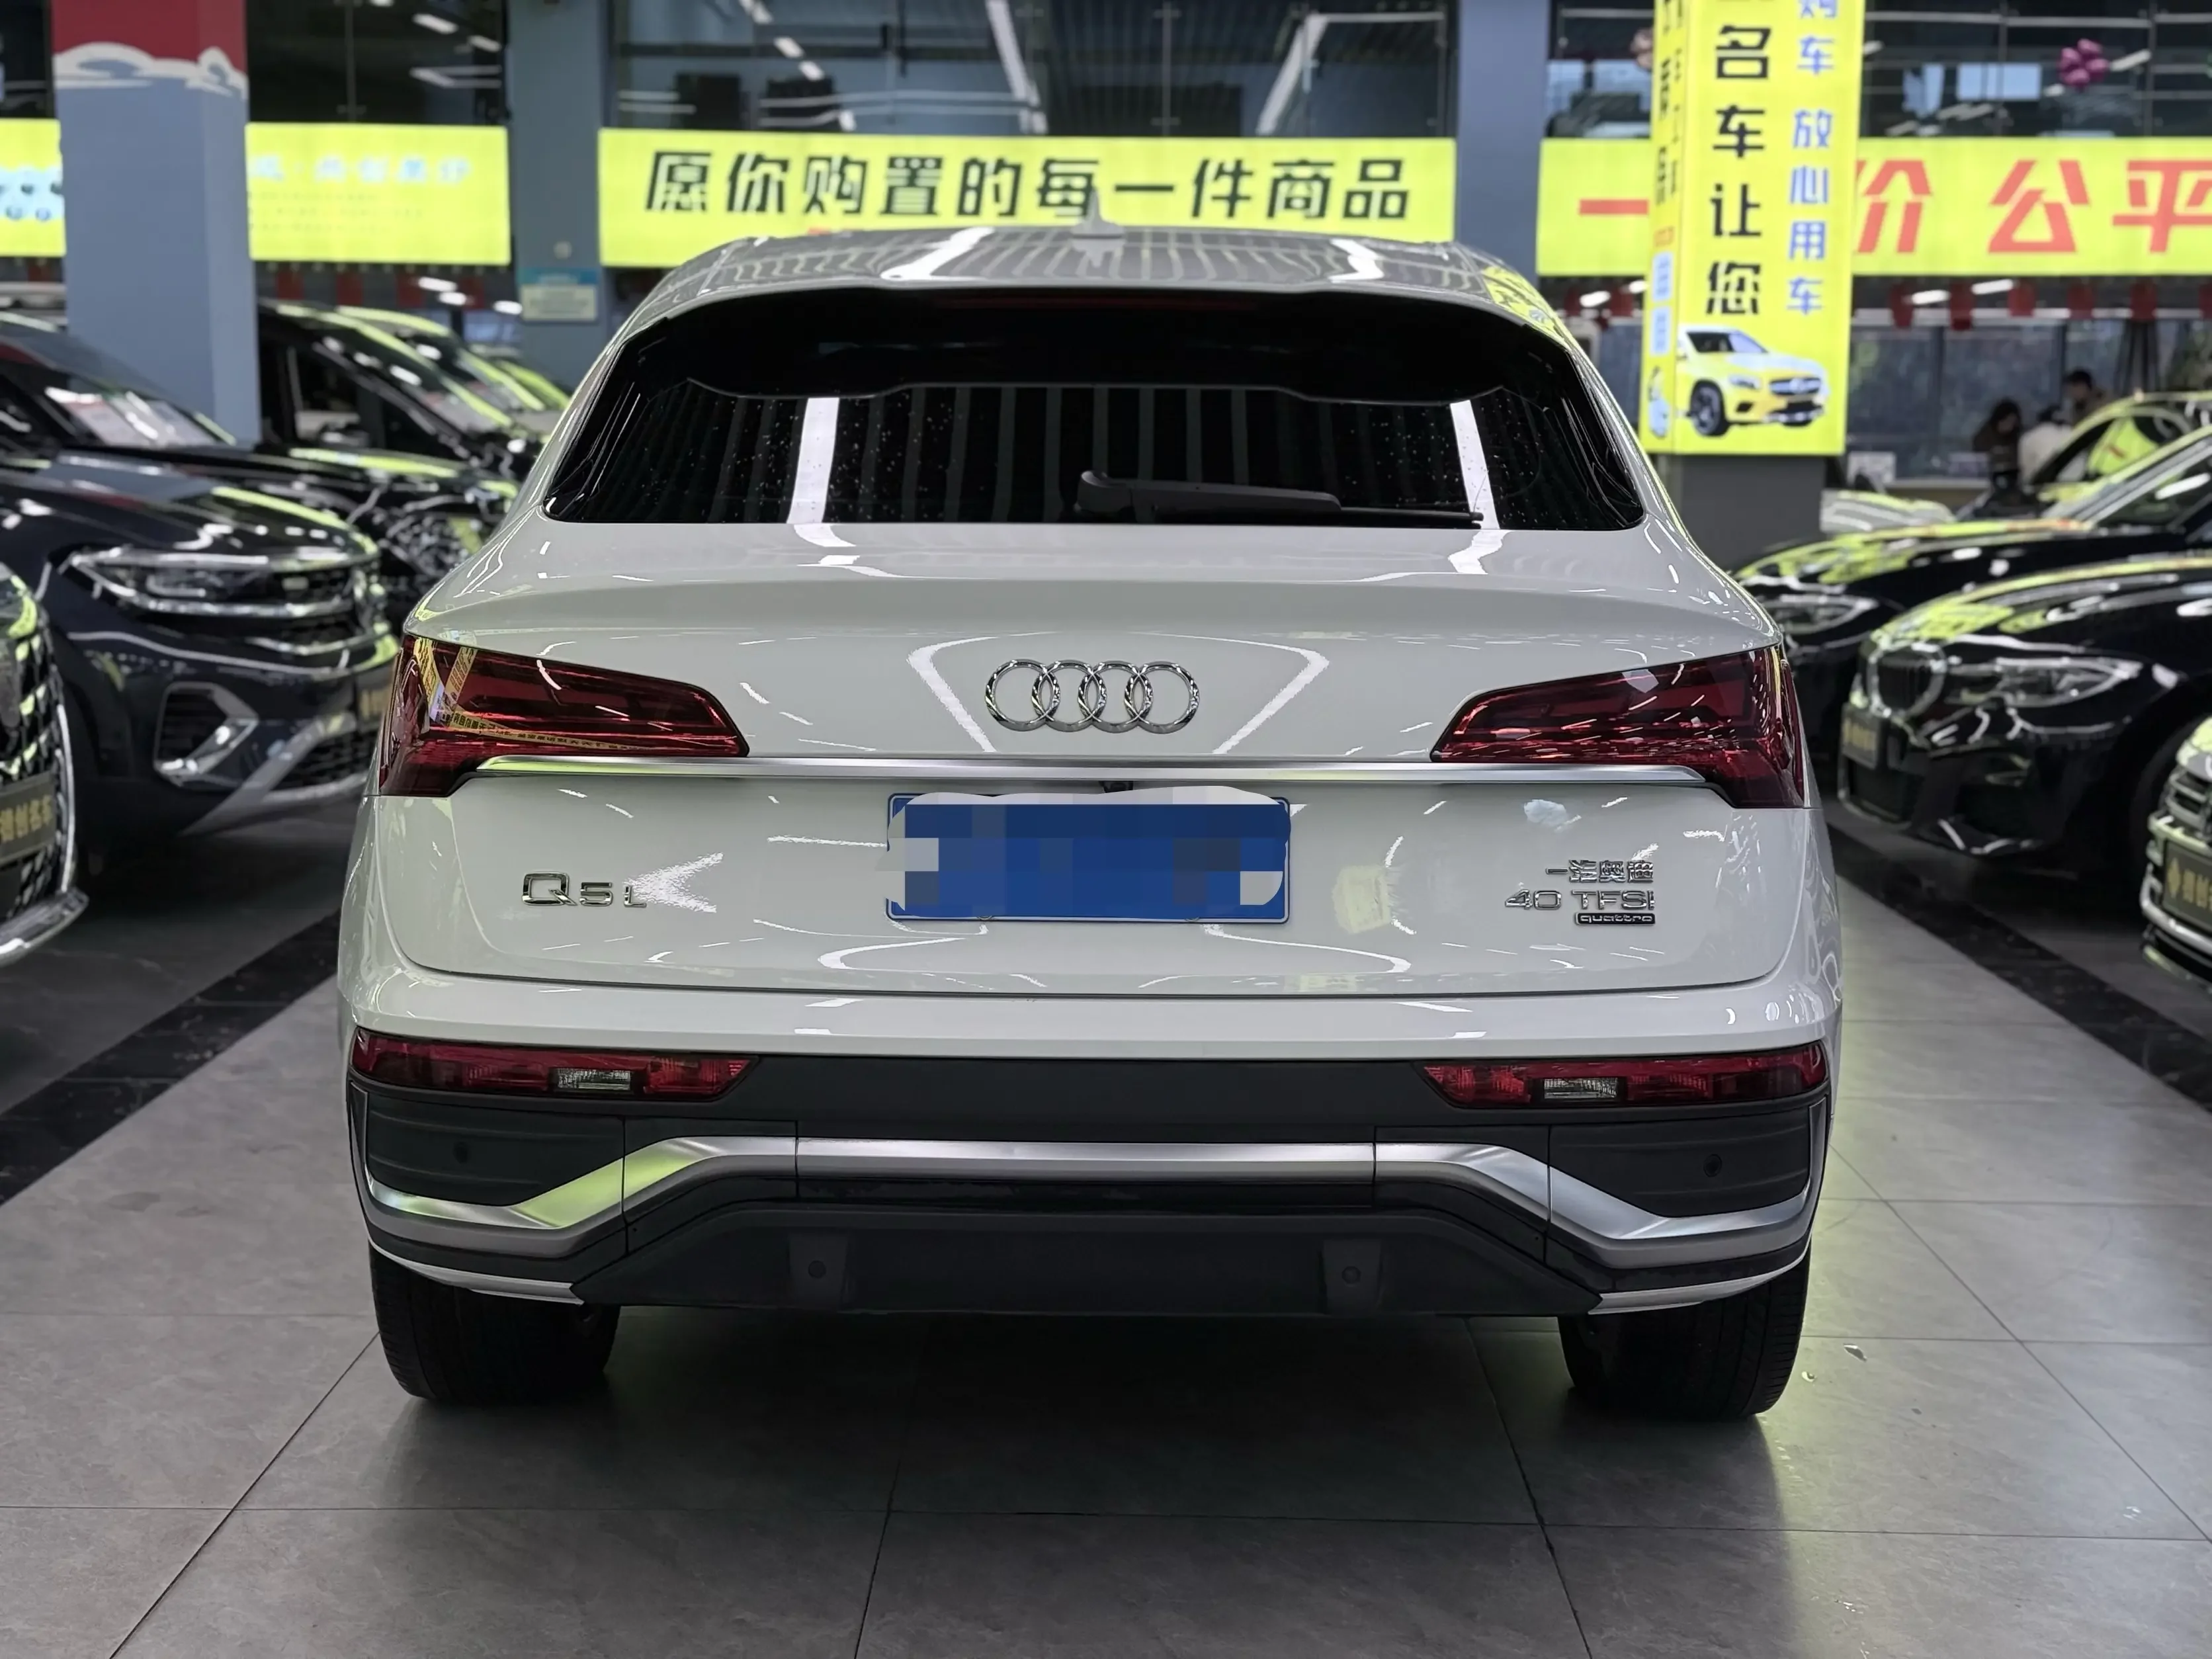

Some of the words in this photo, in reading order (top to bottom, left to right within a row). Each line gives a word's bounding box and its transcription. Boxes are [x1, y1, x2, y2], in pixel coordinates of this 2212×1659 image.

[645, 151, 1410, 220] 愿你购置的每一件商品
[1705, 25, 1771, 316] 名车让您
[1505, 889, 1562, 910] 40
[1571, 890, 1655, 910] TFSI
[1580, 914, 1652, 923] quattro
